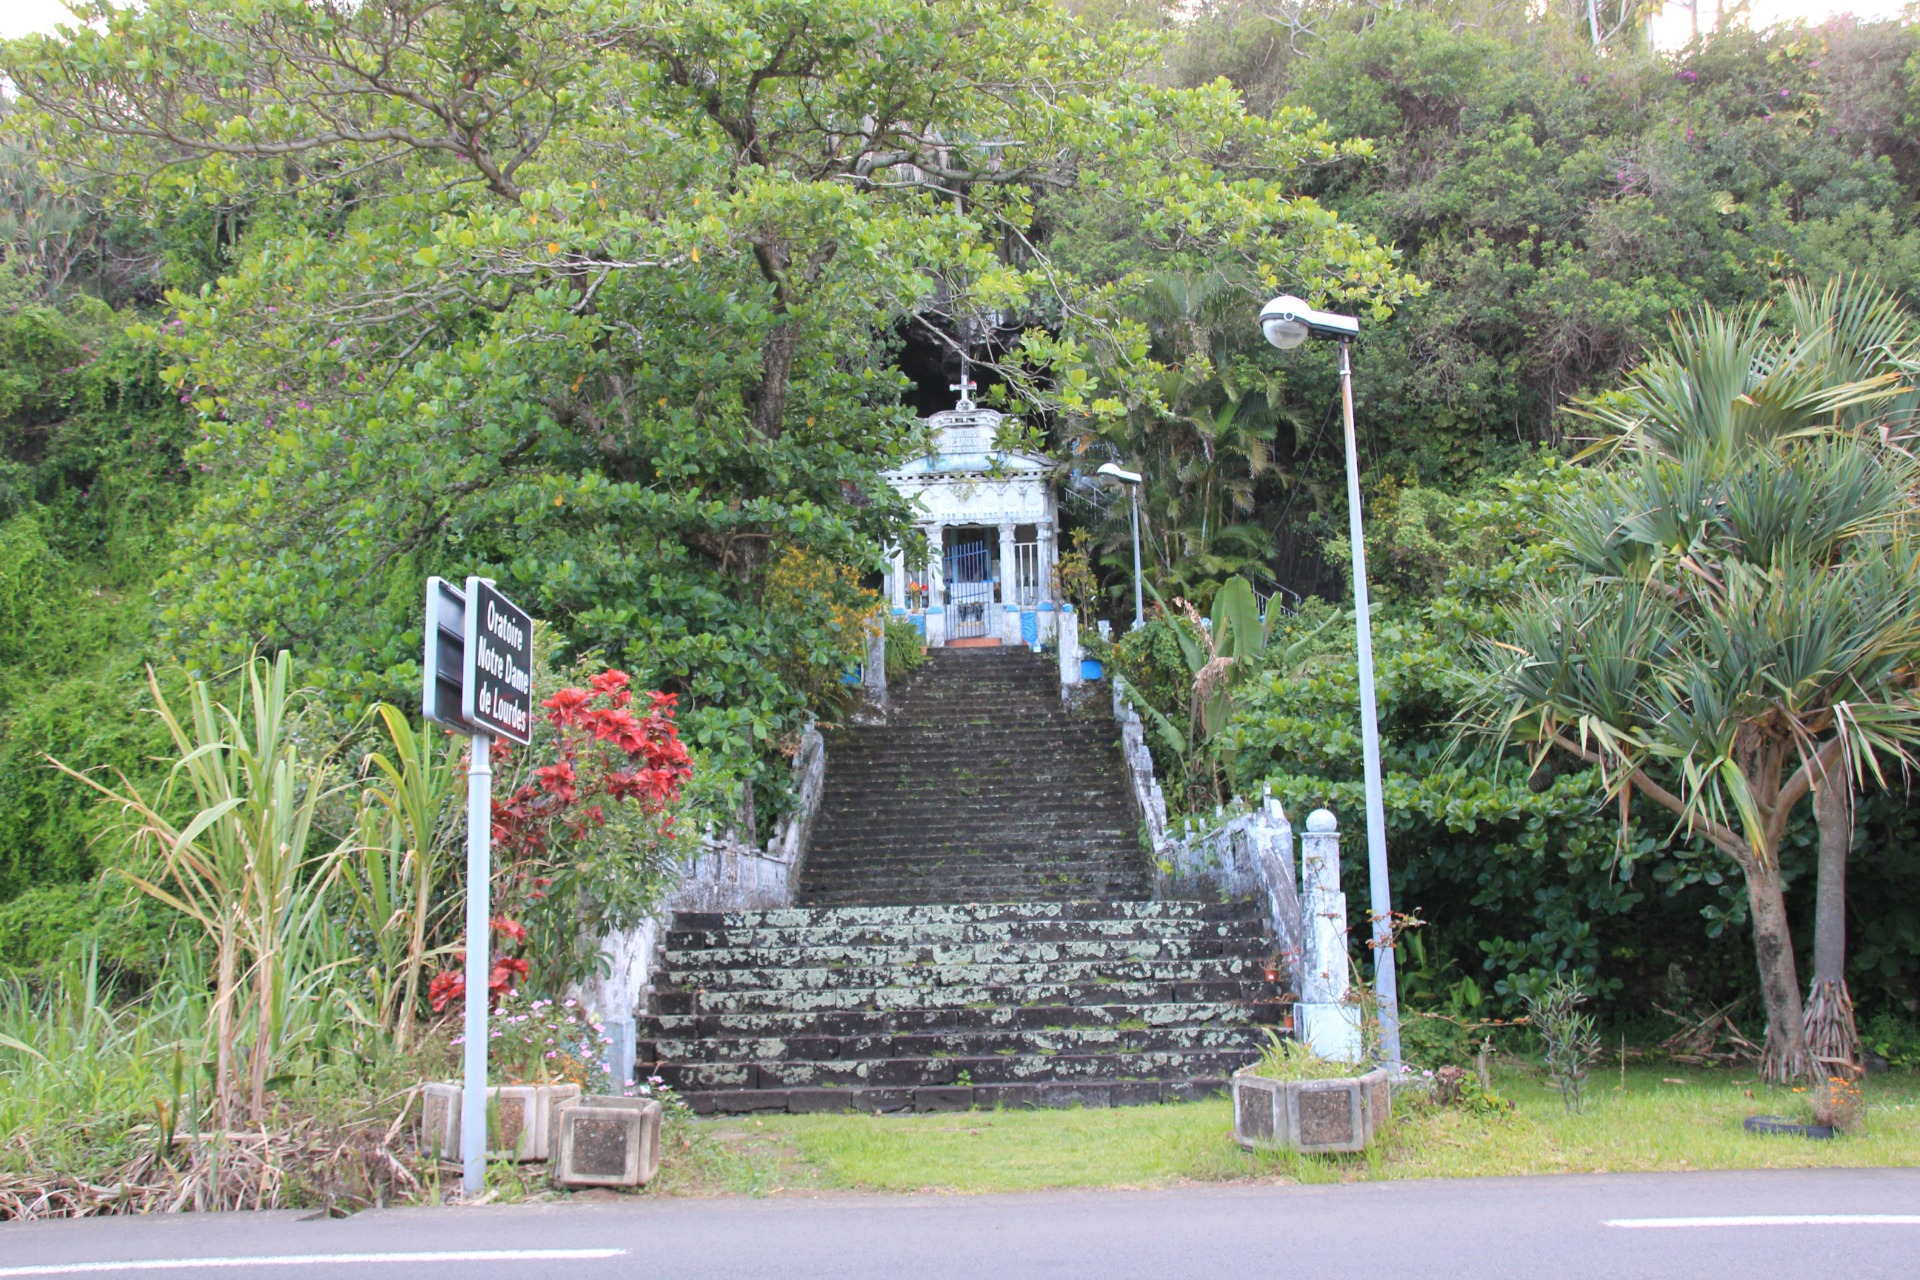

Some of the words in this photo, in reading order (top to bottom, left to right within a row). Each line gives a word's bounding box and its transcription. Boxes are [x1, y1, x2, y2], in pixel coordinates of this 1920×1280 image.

[487, 600, 523, 651] Oratoire
[477, 635, 504, 679] Notre
[504, 653, 529, 695] Dame
[479, 681, 491, 714] de
[492, 687, 527, 732] Lourdes
